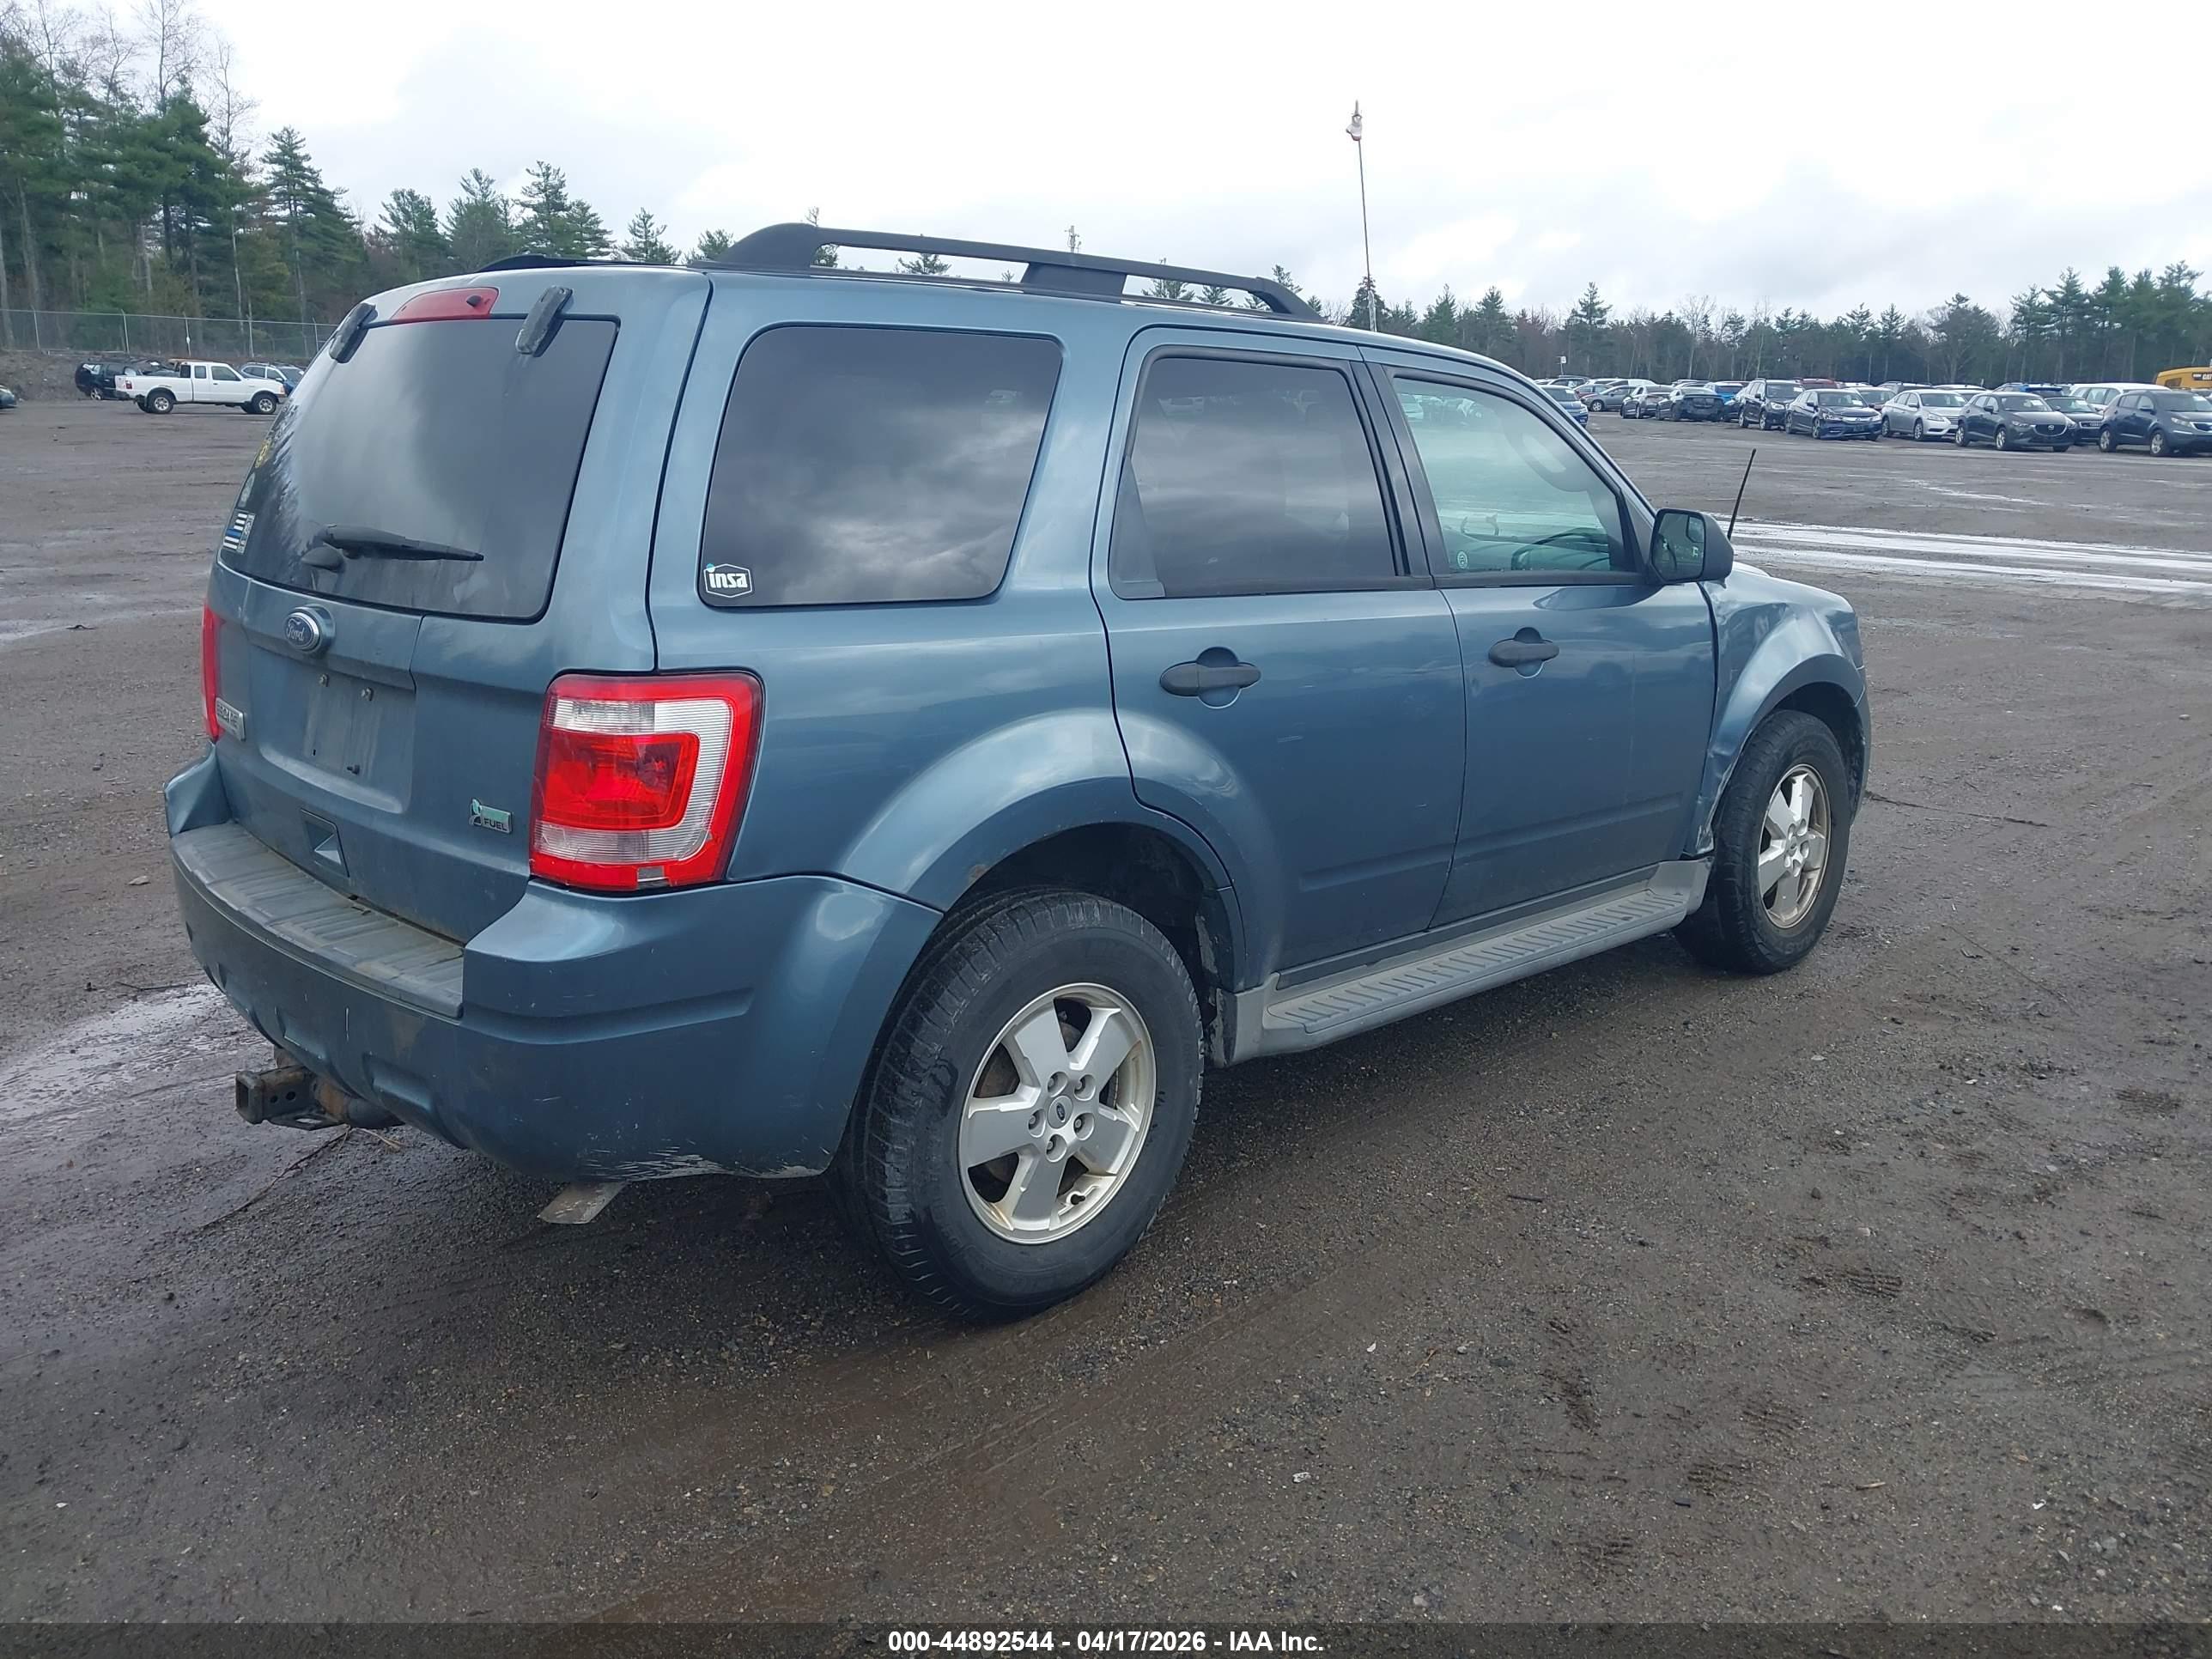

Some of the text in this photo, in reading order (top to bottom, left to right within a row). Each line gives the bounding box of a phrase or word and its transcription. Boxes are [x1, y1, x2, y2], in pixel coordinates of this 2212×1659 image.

[707, 563, 748, 588] insa
[286, 618, 305, 641] Ford
[483, 817, 508, 831] FUEL
